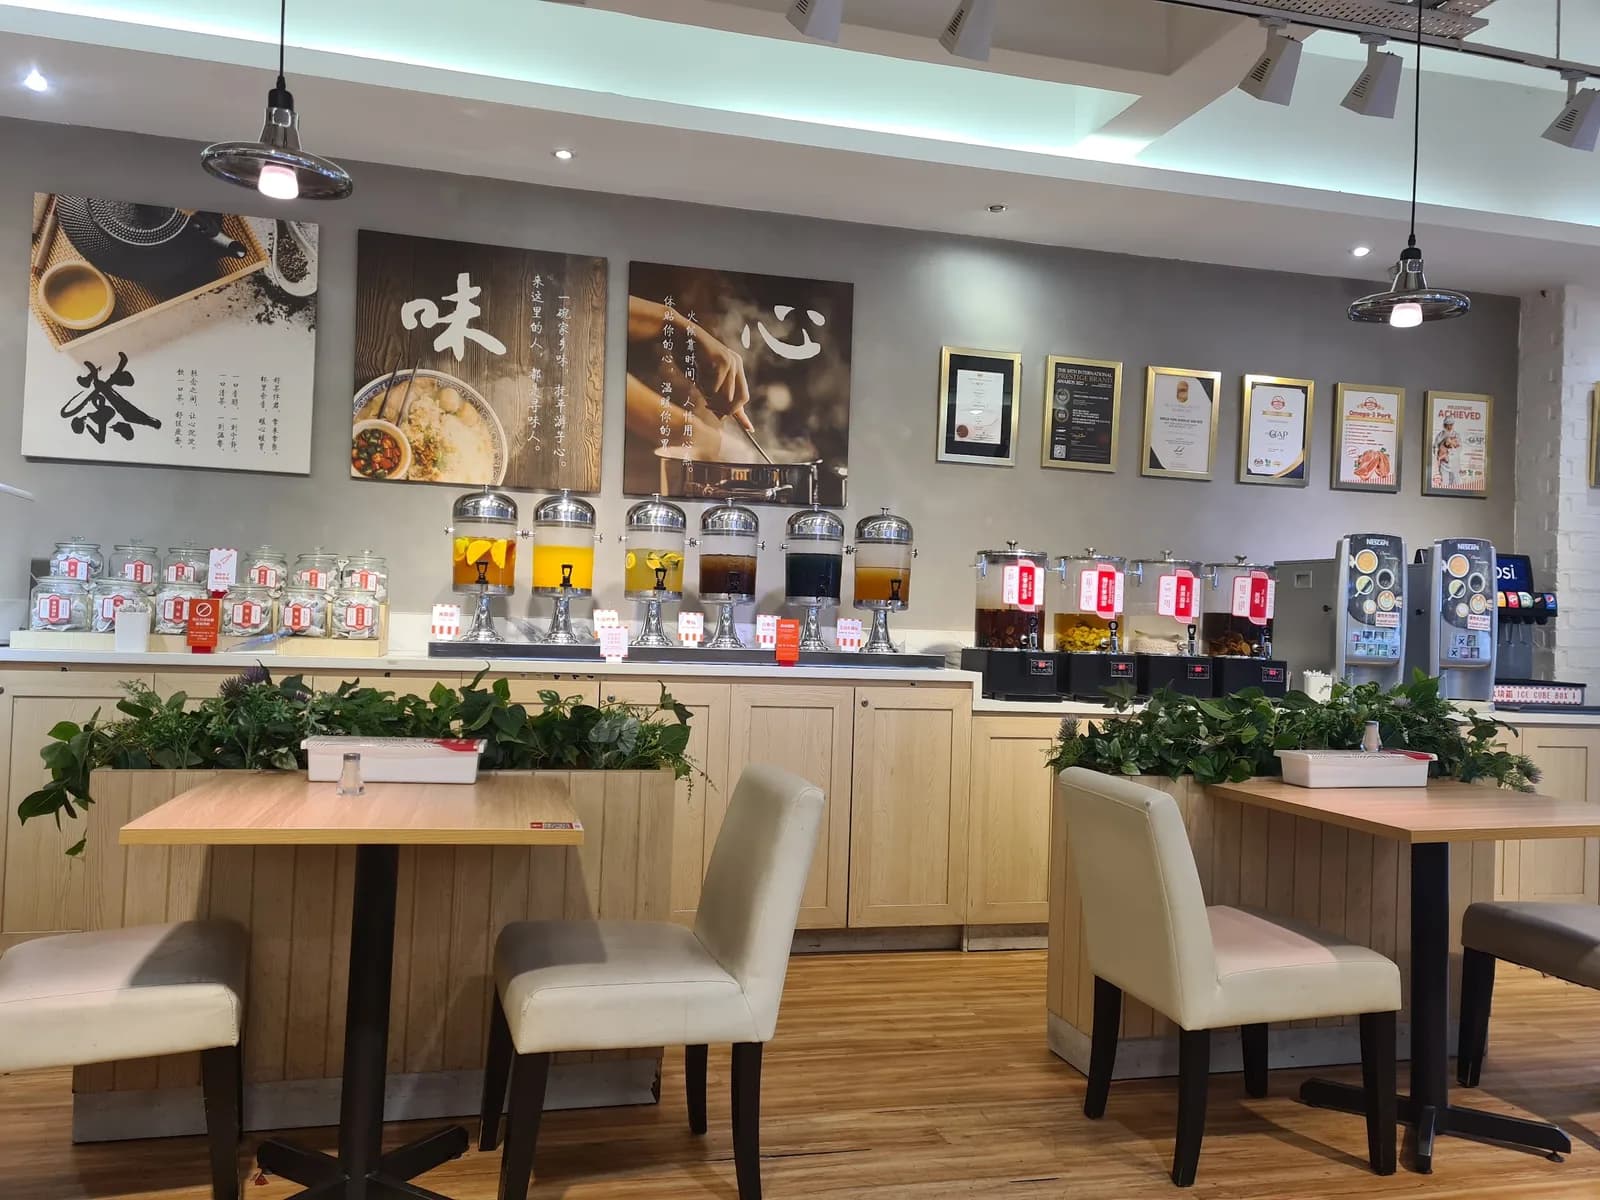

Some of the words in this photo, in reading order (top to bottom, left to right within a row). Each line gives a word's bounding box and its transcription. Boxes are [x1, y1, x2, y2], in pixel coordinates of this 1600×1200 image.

[401, 272, 507, 362] 味
[741, 304, 826, 360] 心
[1057, 372, 1089, 381] PRESTIGE
[60, 351, 162, 444] 茶
[1349, 410, 1375, 418] Omega-3
[1438, 409, 1481, 420] ACHIEVED
[1517, 691, 1529, 699] ICE
[1533, 691, 1550, 699] CUBE
